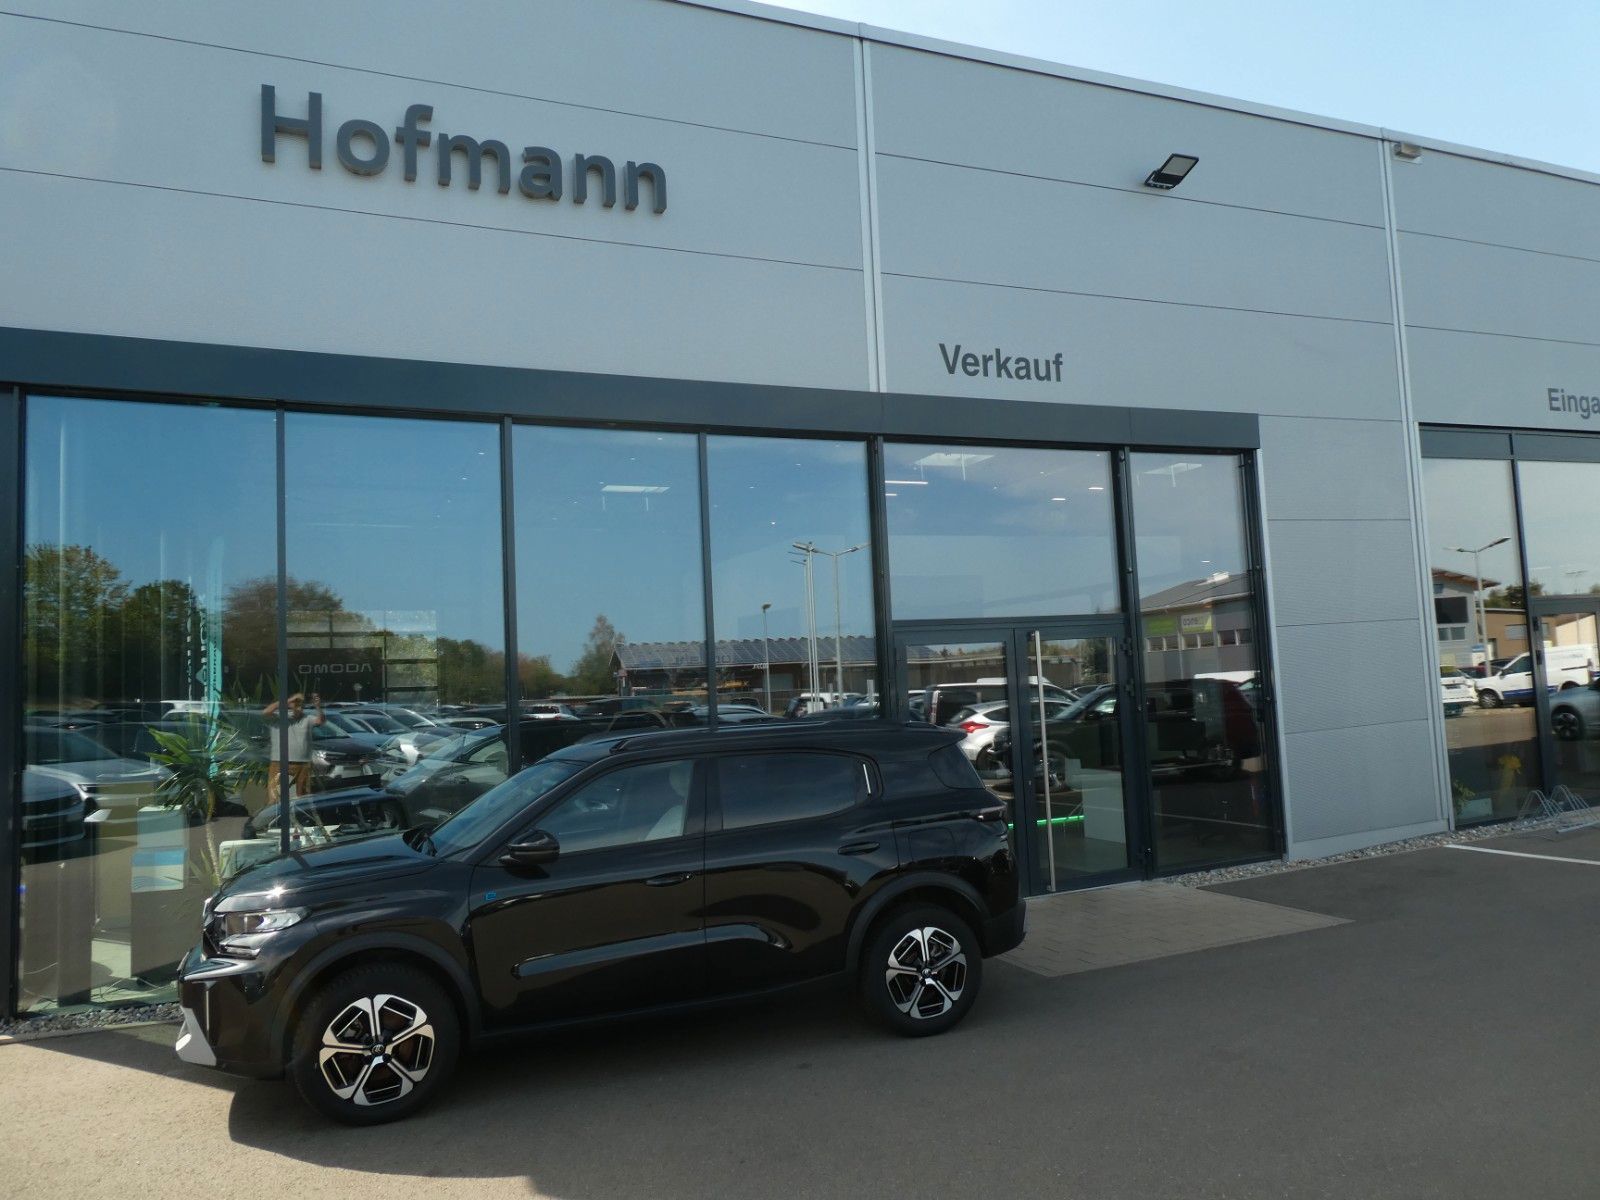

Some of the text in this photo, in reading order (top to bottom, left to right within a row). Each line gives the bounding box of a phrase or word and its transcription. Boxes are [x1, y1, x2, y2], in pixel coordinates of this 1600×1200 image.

[261, 84, 667, 214] Hofmann
[939, 343, 1063, 382] Verkauf
[1548, 388, 1600, 419] Einga
[298, 663, 372, 674] OMODA
